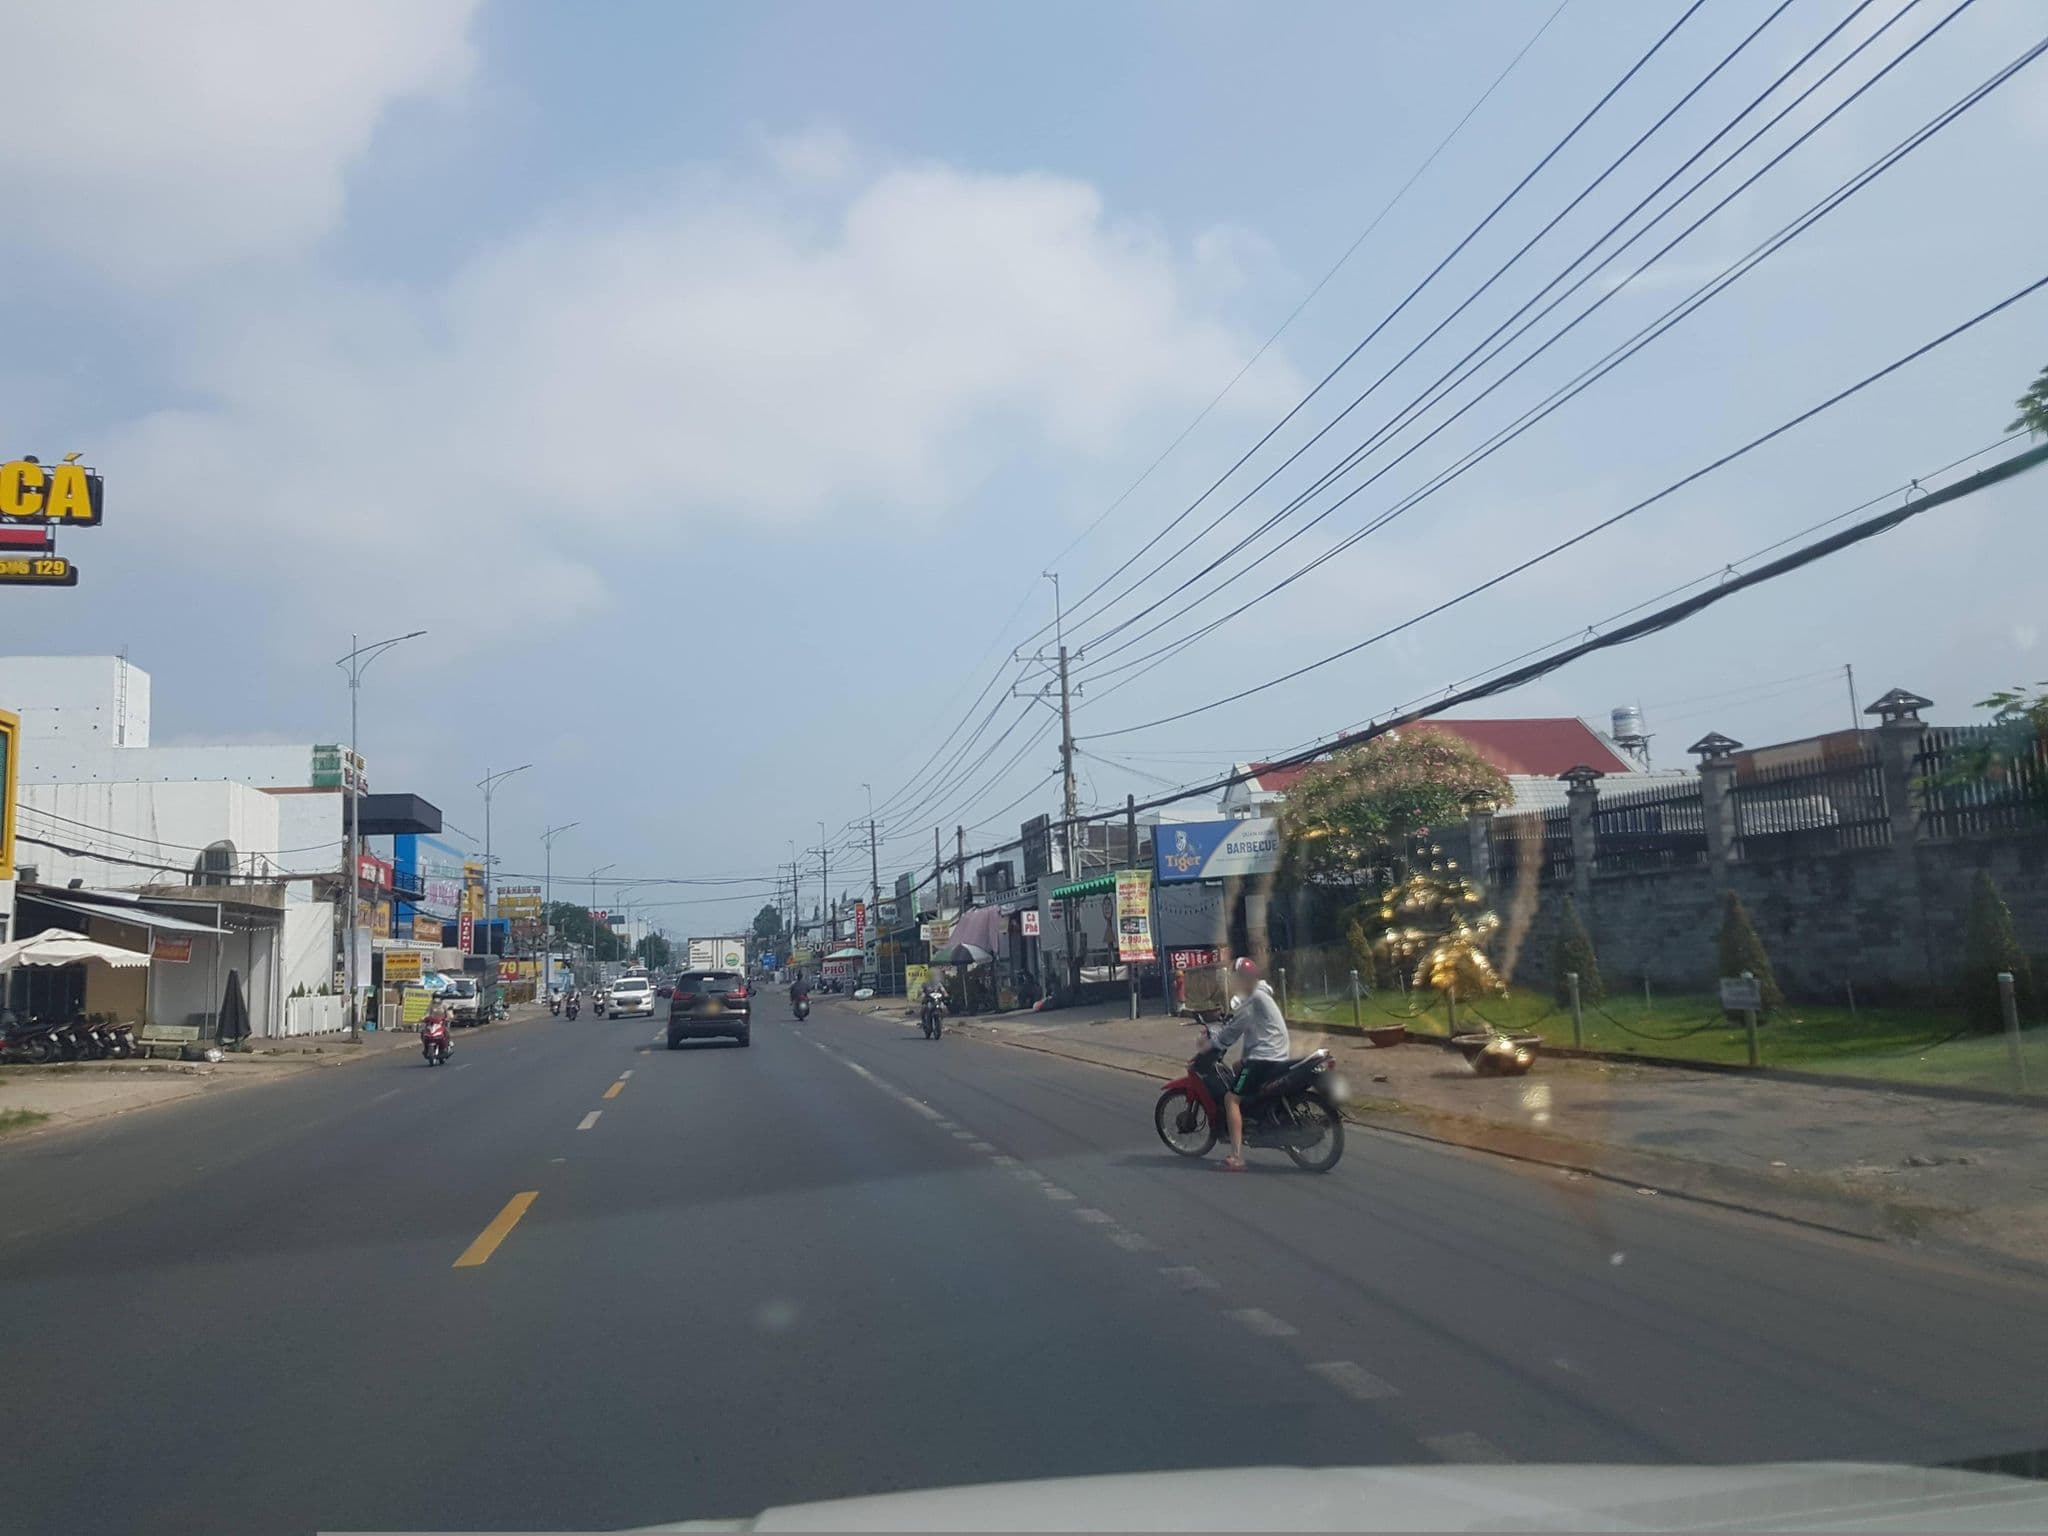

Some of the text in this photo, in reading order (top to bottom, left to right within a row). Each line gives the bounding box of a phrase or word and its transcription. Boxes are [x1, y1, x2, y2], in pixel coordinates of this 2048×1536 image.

[0, 452, 93, 518] CÁ
[33, 560, 65, 575] 129
[1226, 840, 1278, 855] BARBECUE
[1165, 853, 1201, 872] Tiger
[498, 960, 517, 974] 79
